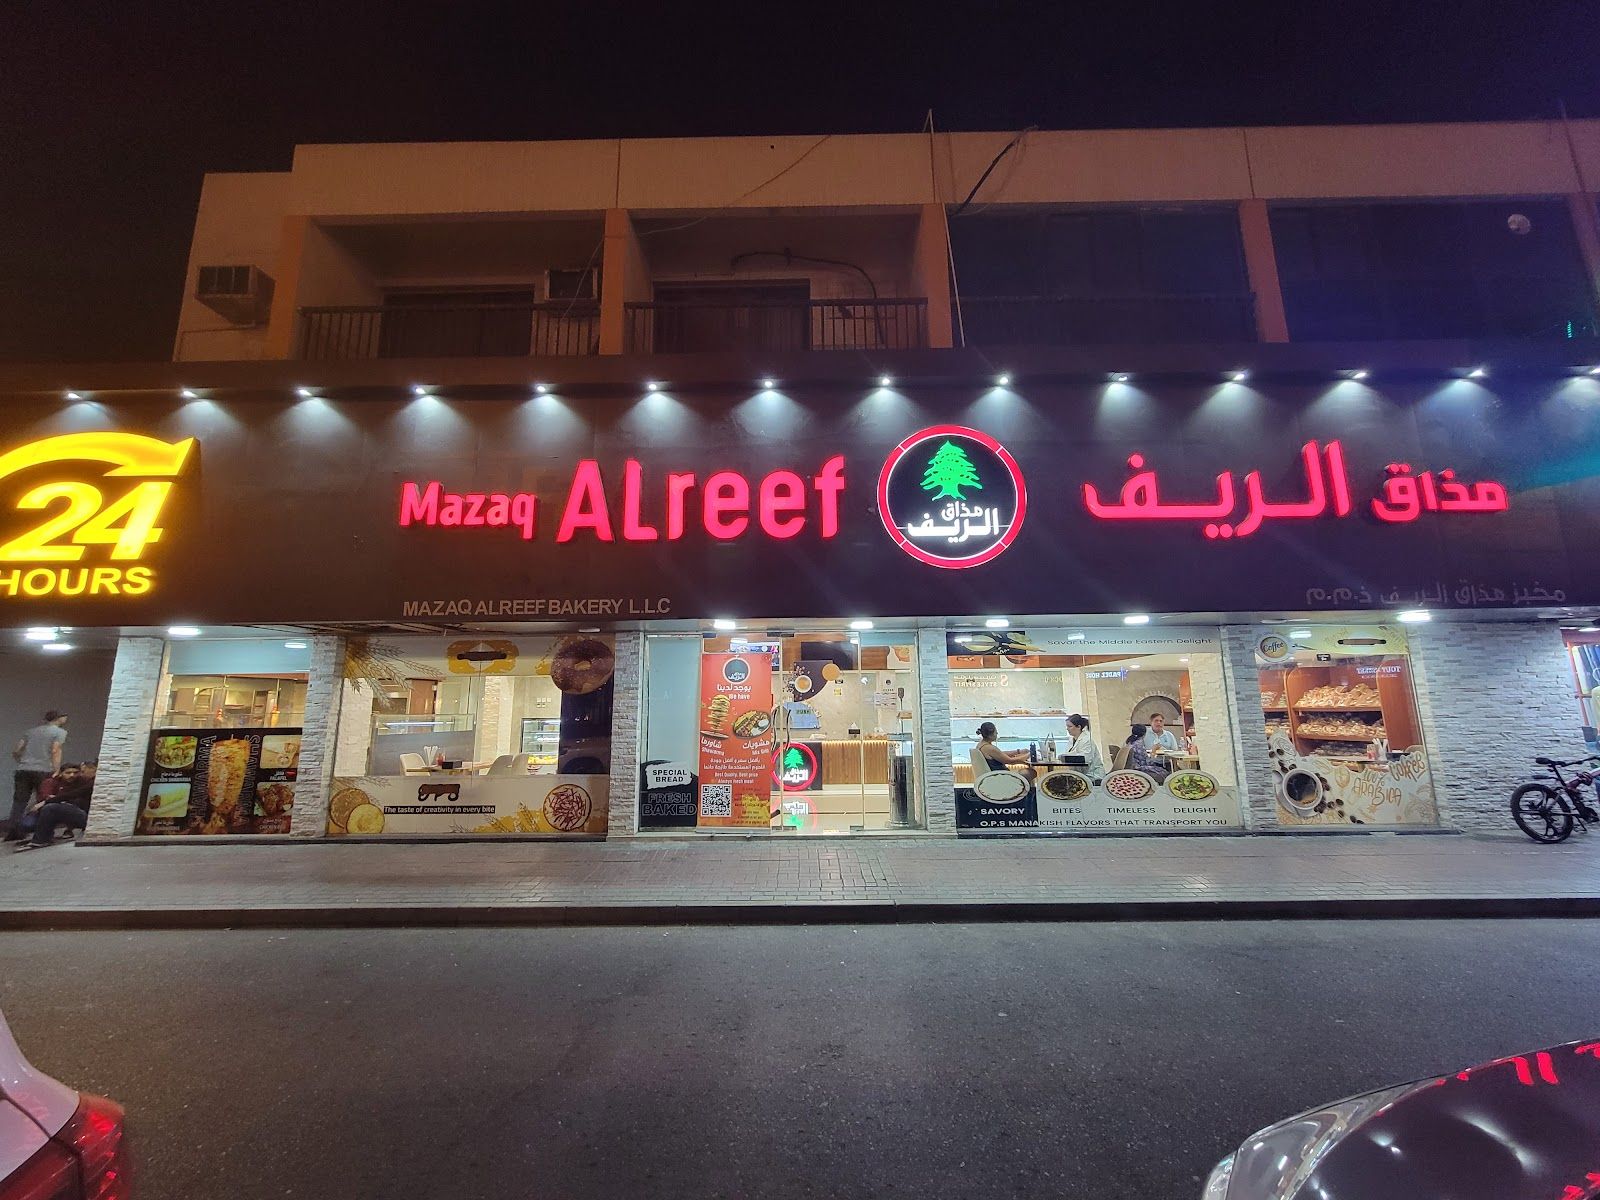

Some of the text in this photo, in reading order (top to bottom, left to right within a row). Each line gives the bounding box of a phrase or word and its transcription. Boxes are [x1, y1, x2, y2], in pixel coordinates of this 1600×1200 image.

[400, 454, 846, 543] Mazaq ALreef
[1081, 439, 1508, 539] مذاق الريف
[941, 501, 983, 521] مذاق
[0, 481, 173, 562] 24
[907, 508, 999, 542] الريف
[1455, 579, 1505, 605] مذاق
[403, 598, 671, 616] MAZAQ ALREEF BAKERY L.L.C
[1262, 641, 1285, 653] Coffee
[647, 792, 692, 804] FRESH
[423, 806, 454, 814] creativity
[481, 805, 495, 813] bite
[641, 803, 698, 816] BAKED
[980, 807, 1025, 815] SAVORY
